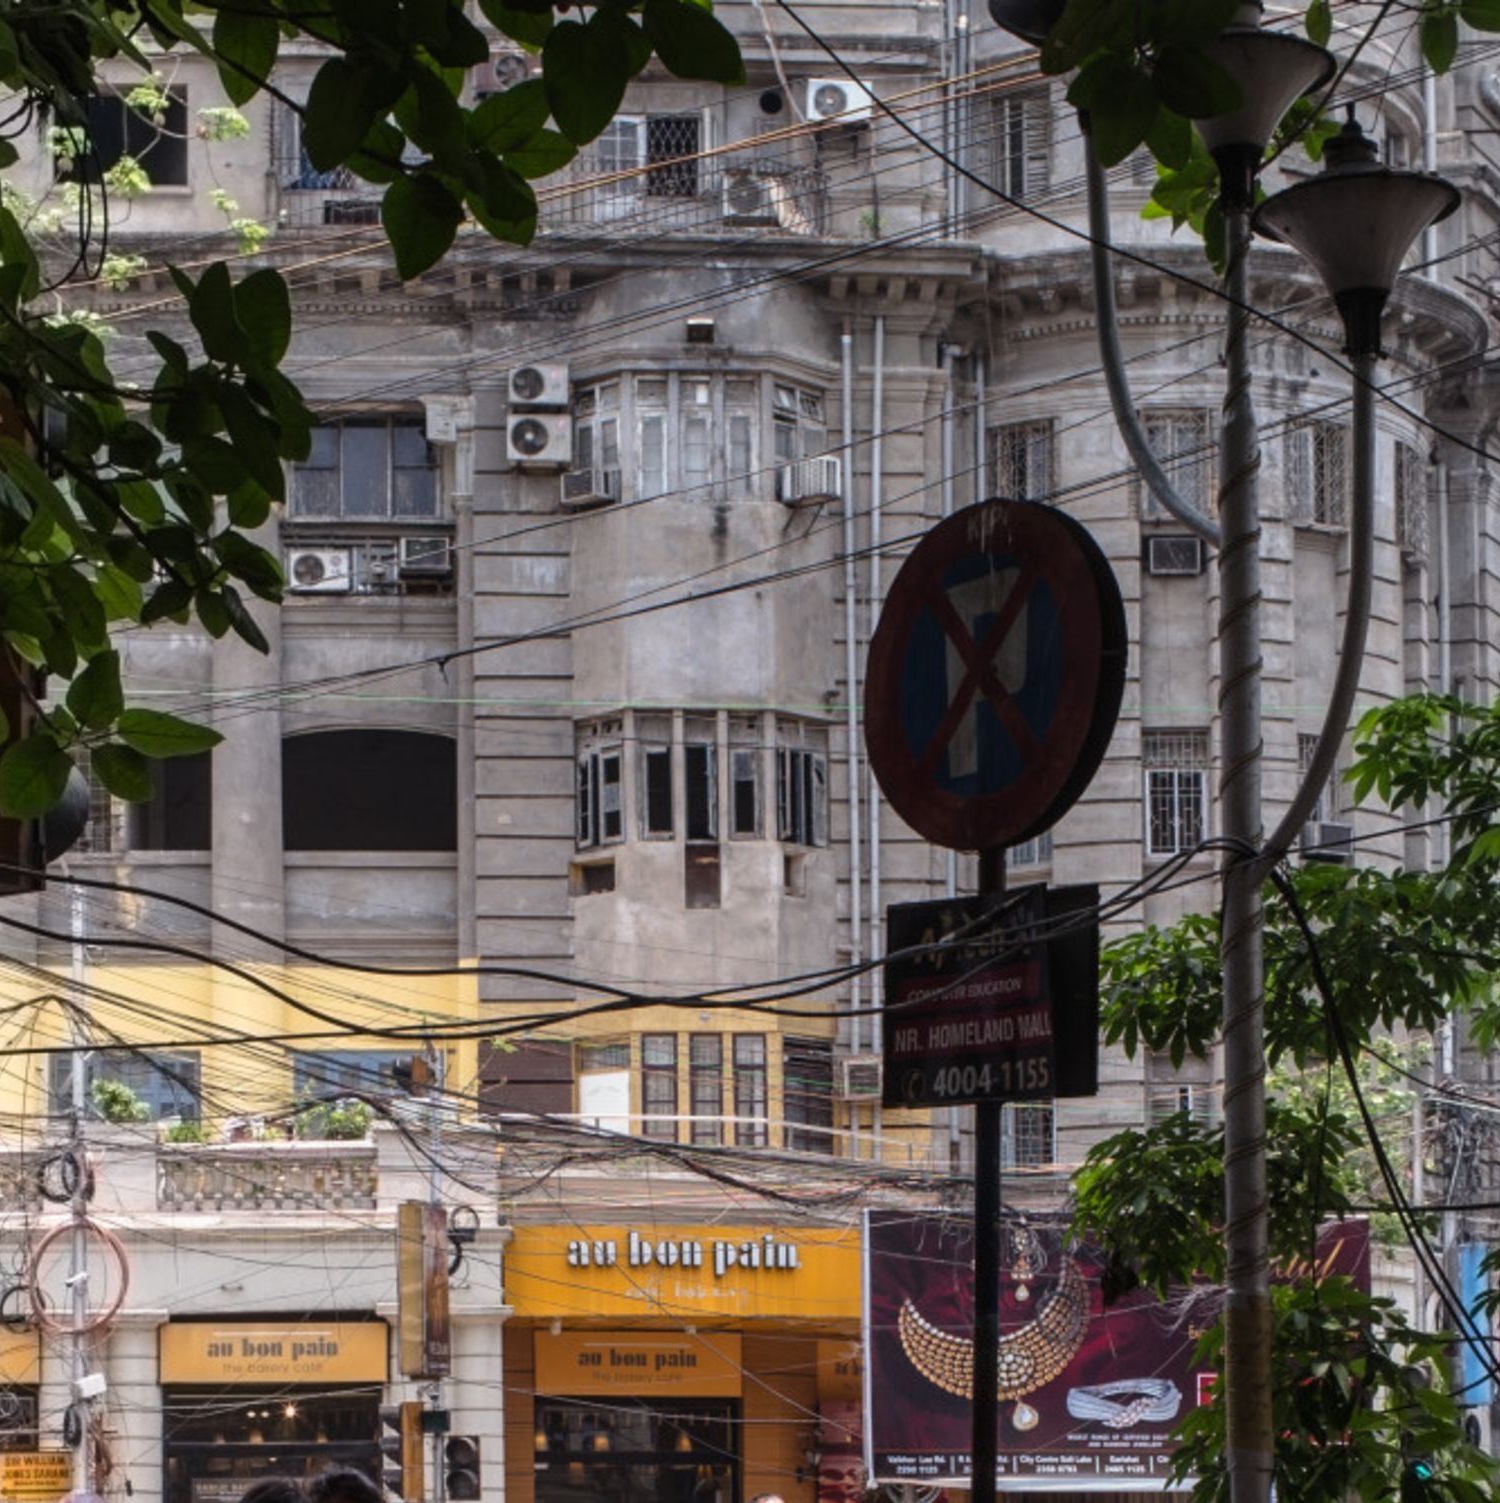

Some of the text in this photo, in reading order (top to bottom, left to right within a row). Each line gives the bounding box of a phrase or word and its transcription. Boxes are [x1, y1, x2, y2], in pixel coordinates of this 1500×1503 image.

[967, 977, 1023, 997] EDUCATION
[894, 1010, 1052, 1052] NR. HOMELAND MALL
[932, 1056, 1049, 1096] 4004-1155
[566, 1230, 798, 1277] au bon pain
[206, 1335, 339, 1361] au bon pain
[577, 1348, 697, 1372] au bon pain
